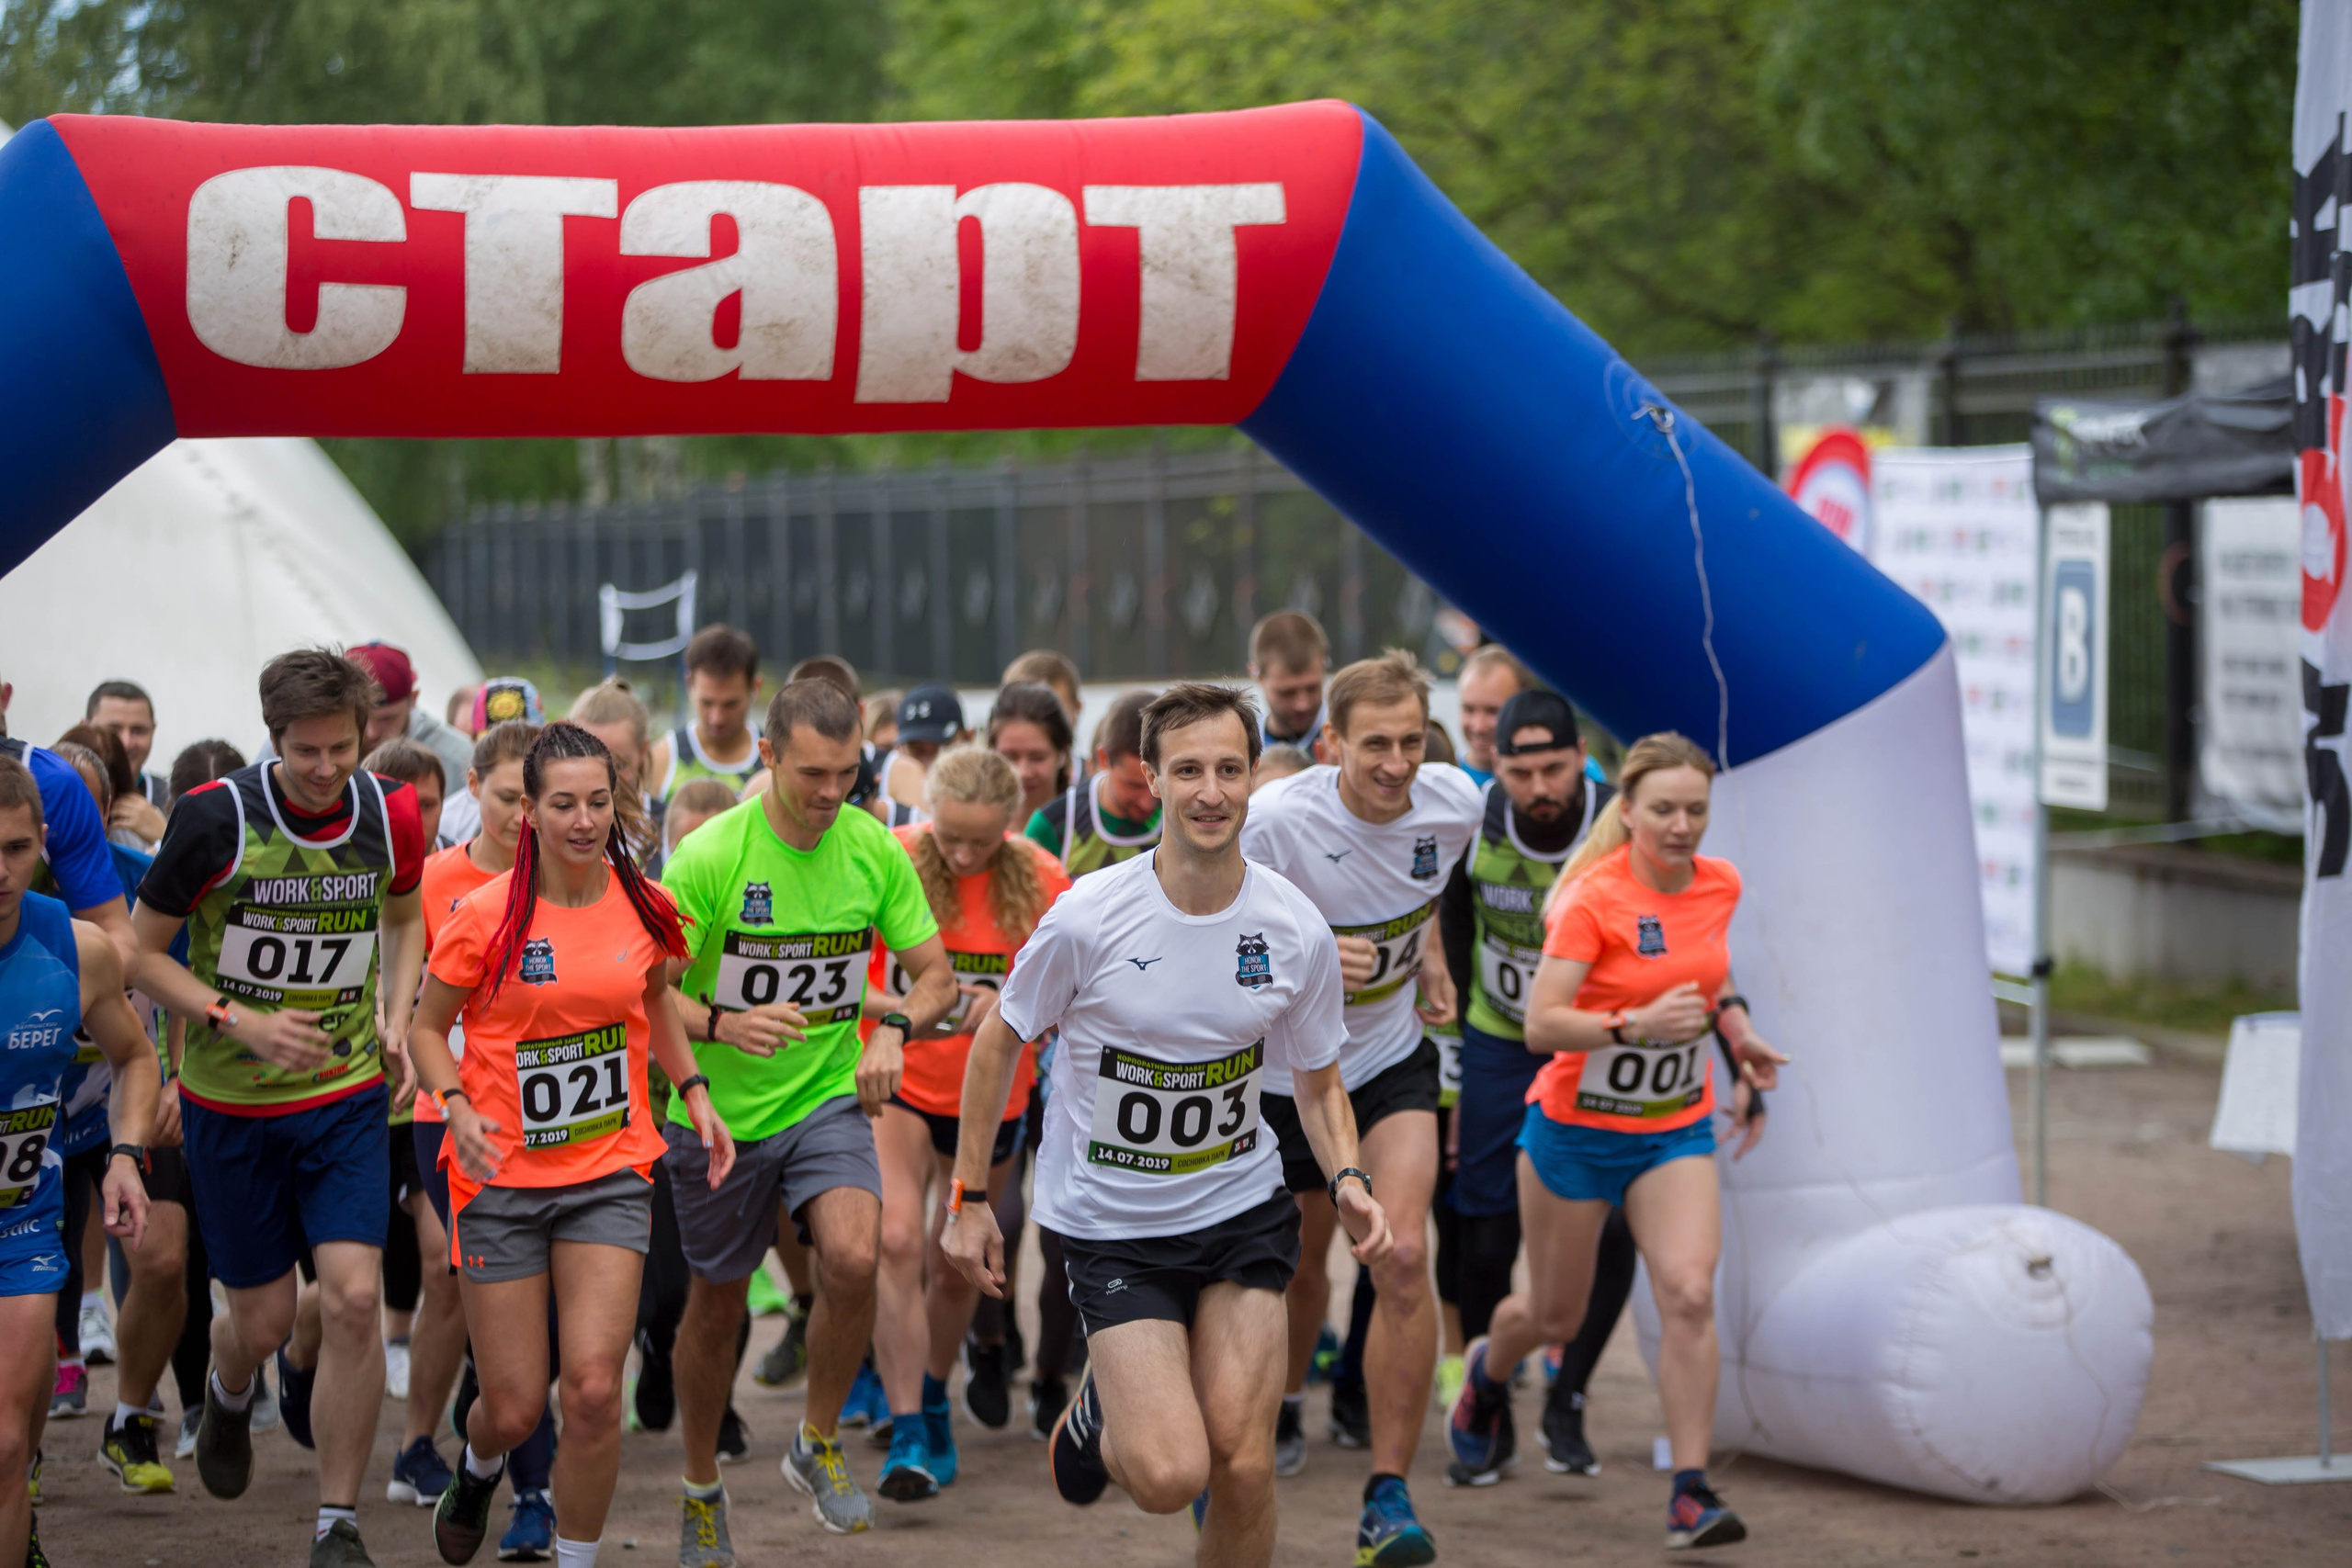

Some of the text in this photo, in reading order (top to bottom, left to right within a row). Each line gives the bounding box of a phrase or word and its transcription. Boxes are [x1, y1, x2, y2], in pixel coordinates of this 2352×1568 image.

[187, 165, 1287, 403] старт
[254, 872, 378, 904] WORK&SPORT
[243, 909, 368, 932] WORK&SPORT RUN
[738, 931, 864, 958] WORK&SPORT RUN
[247, 936, 352, 985] 017
[957, 953, 1007, 973] RUN
[1241, 964, 1267, 973] THE SPORT
[1244, 955, 1262, 964] HONOR
[222, 979, 283, 1001] 14.07.2019
[741, 959, 851, 1006] 023
[7, 1027, 62, 1050] БЕРЕГ
[516, 1038, 563, 1051] ПОРАТИВНЫЙ
[516, 1043, 583, 1067] ORK&SPORT
[1117, 1054, 1205, 1073] КОРПОРАТИВНЫЙ ЗАБЕГ
[1116, 1046, 1255, 1089] WORK&SPORT RUN
[1609, 1046, 1699, 1093] 001
[523, 1056, 628, 1122] 021
[1117, 1079, 1249, 1147] 003
[1097, 1147, 1170, 1169] 14.07.2019
[1178, 1149, 1225, 1168] СОСНОВКА ПАРК
